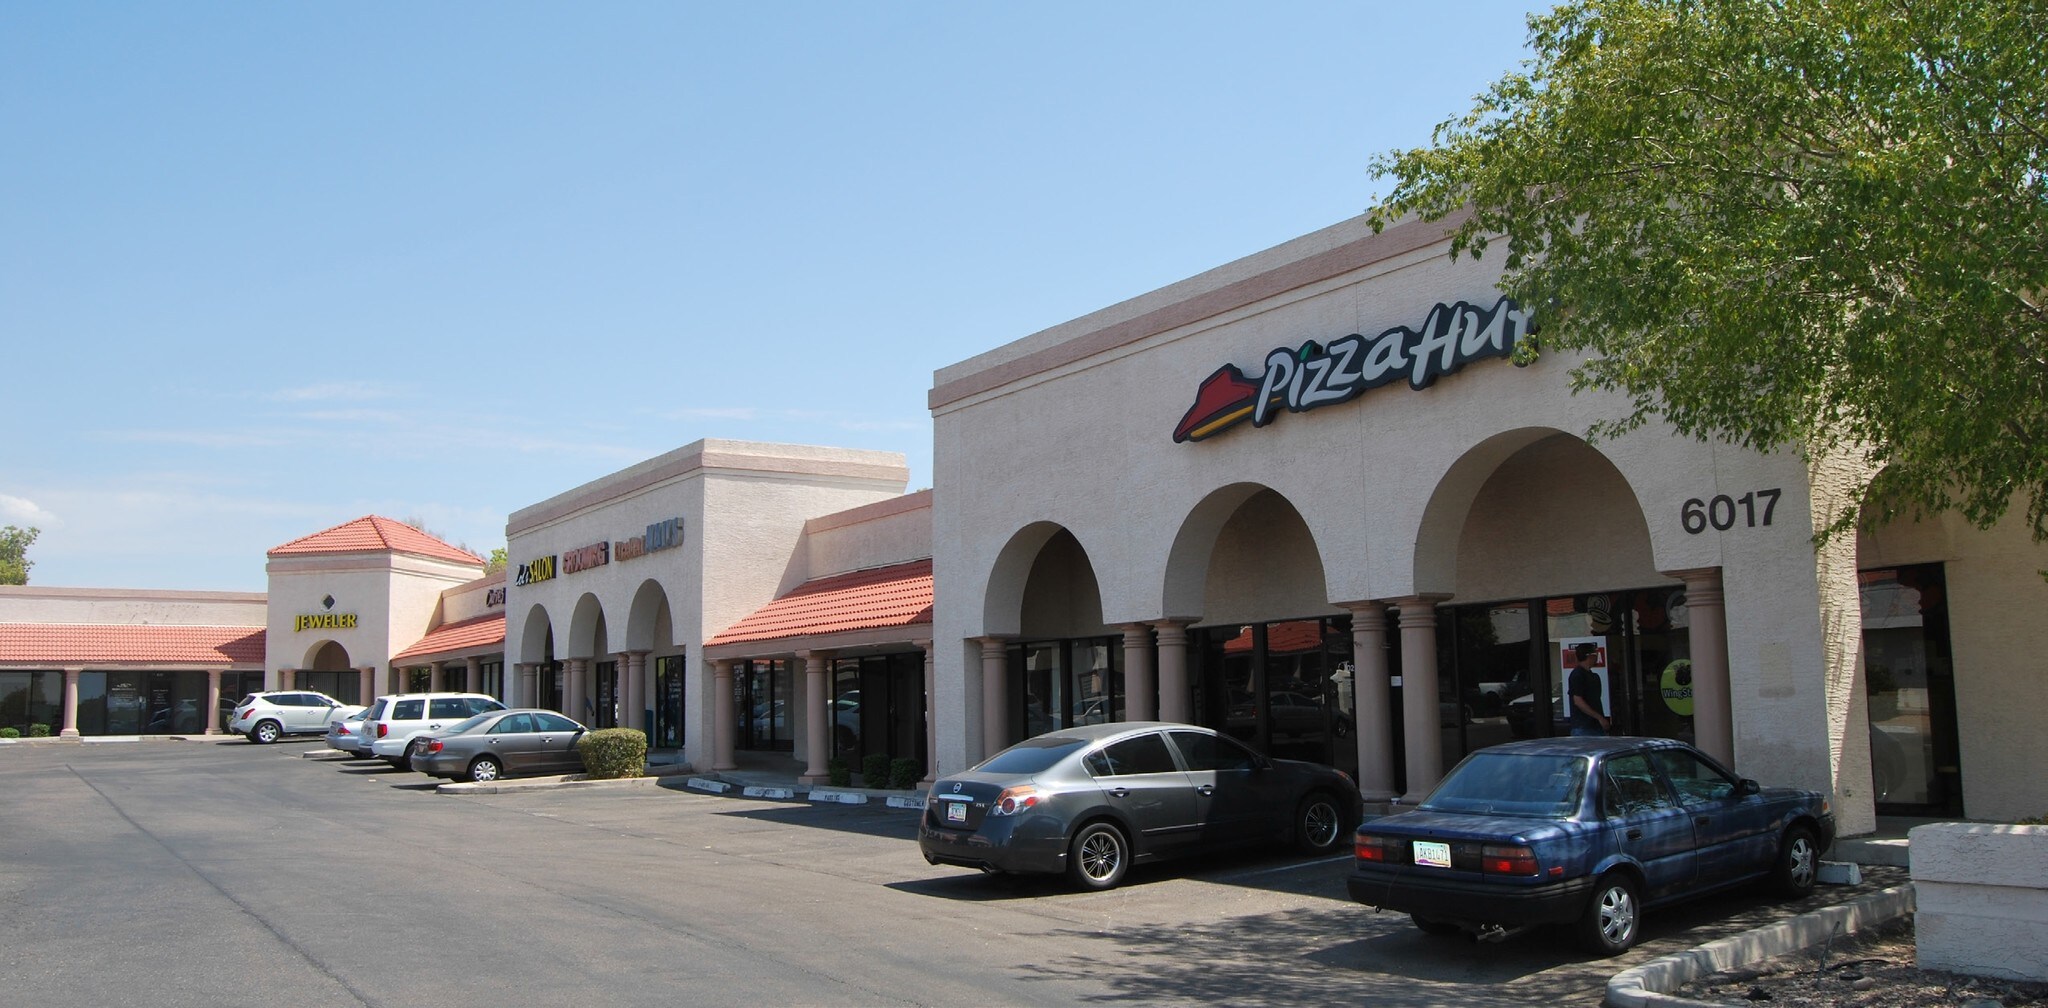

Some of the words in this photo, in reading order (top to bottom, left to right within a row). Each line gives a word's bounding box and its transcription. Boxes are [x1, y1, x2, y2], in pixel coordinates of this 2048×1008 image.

[1254, 330, 1408, 423] Pizza
[1681, 488, 1782, 535] 6017
[529, 555, 557, 584] SALON
[294, 614, 358, 632] JEWELER
[1662, 687, 1694, 700] WingSt
